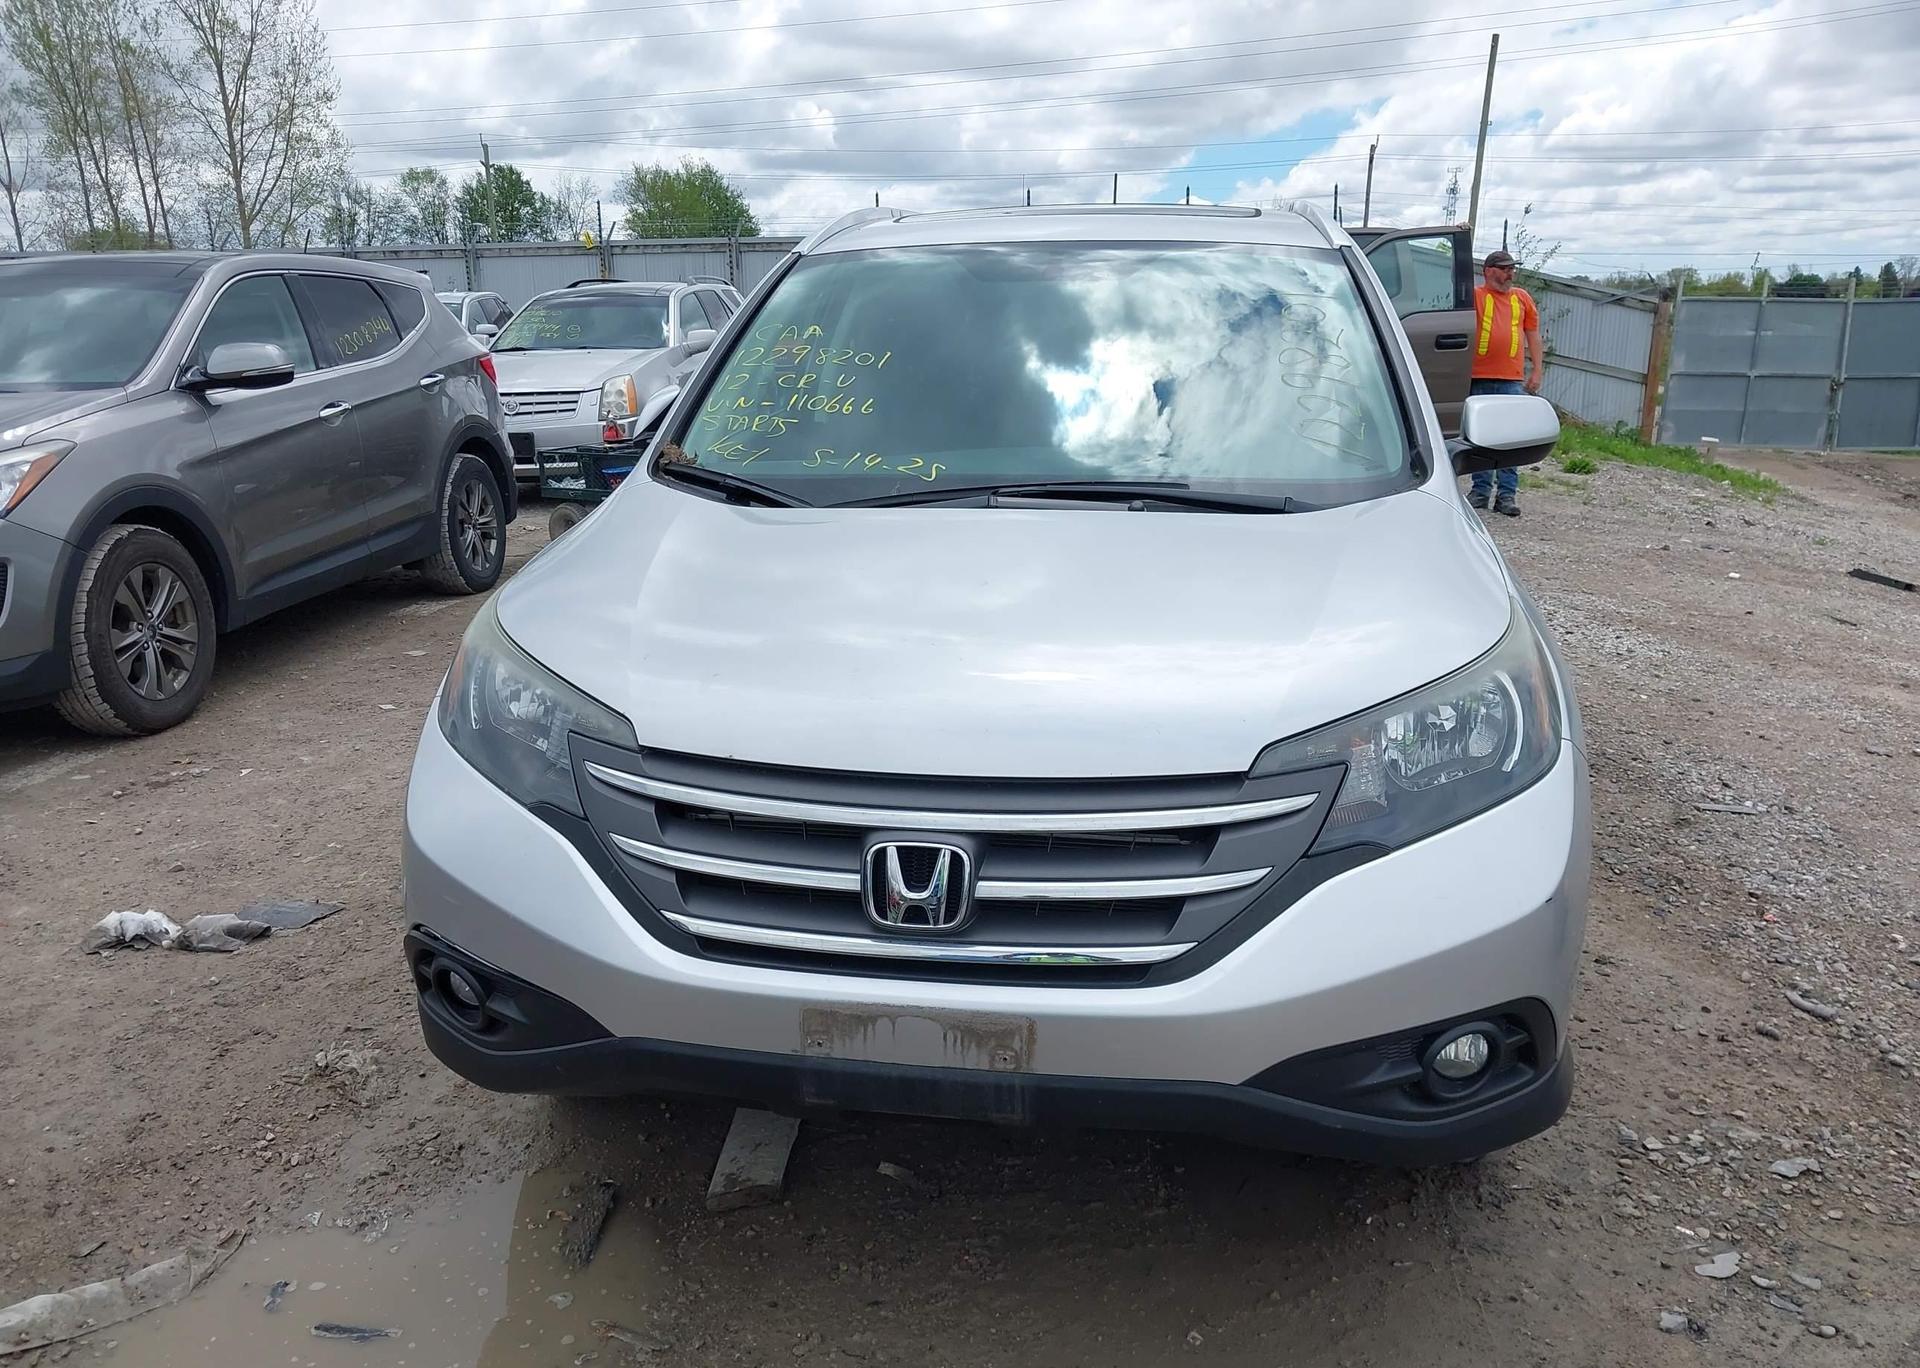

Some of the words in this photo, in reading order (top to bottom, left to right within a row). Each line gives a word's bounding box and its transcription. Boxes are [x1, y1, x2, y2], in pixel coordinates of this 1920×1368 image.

[755, 324, 824, 342] CAA
[732, 345, 892, 369] 12298201
[702, 414, 799, 438] STARTS
